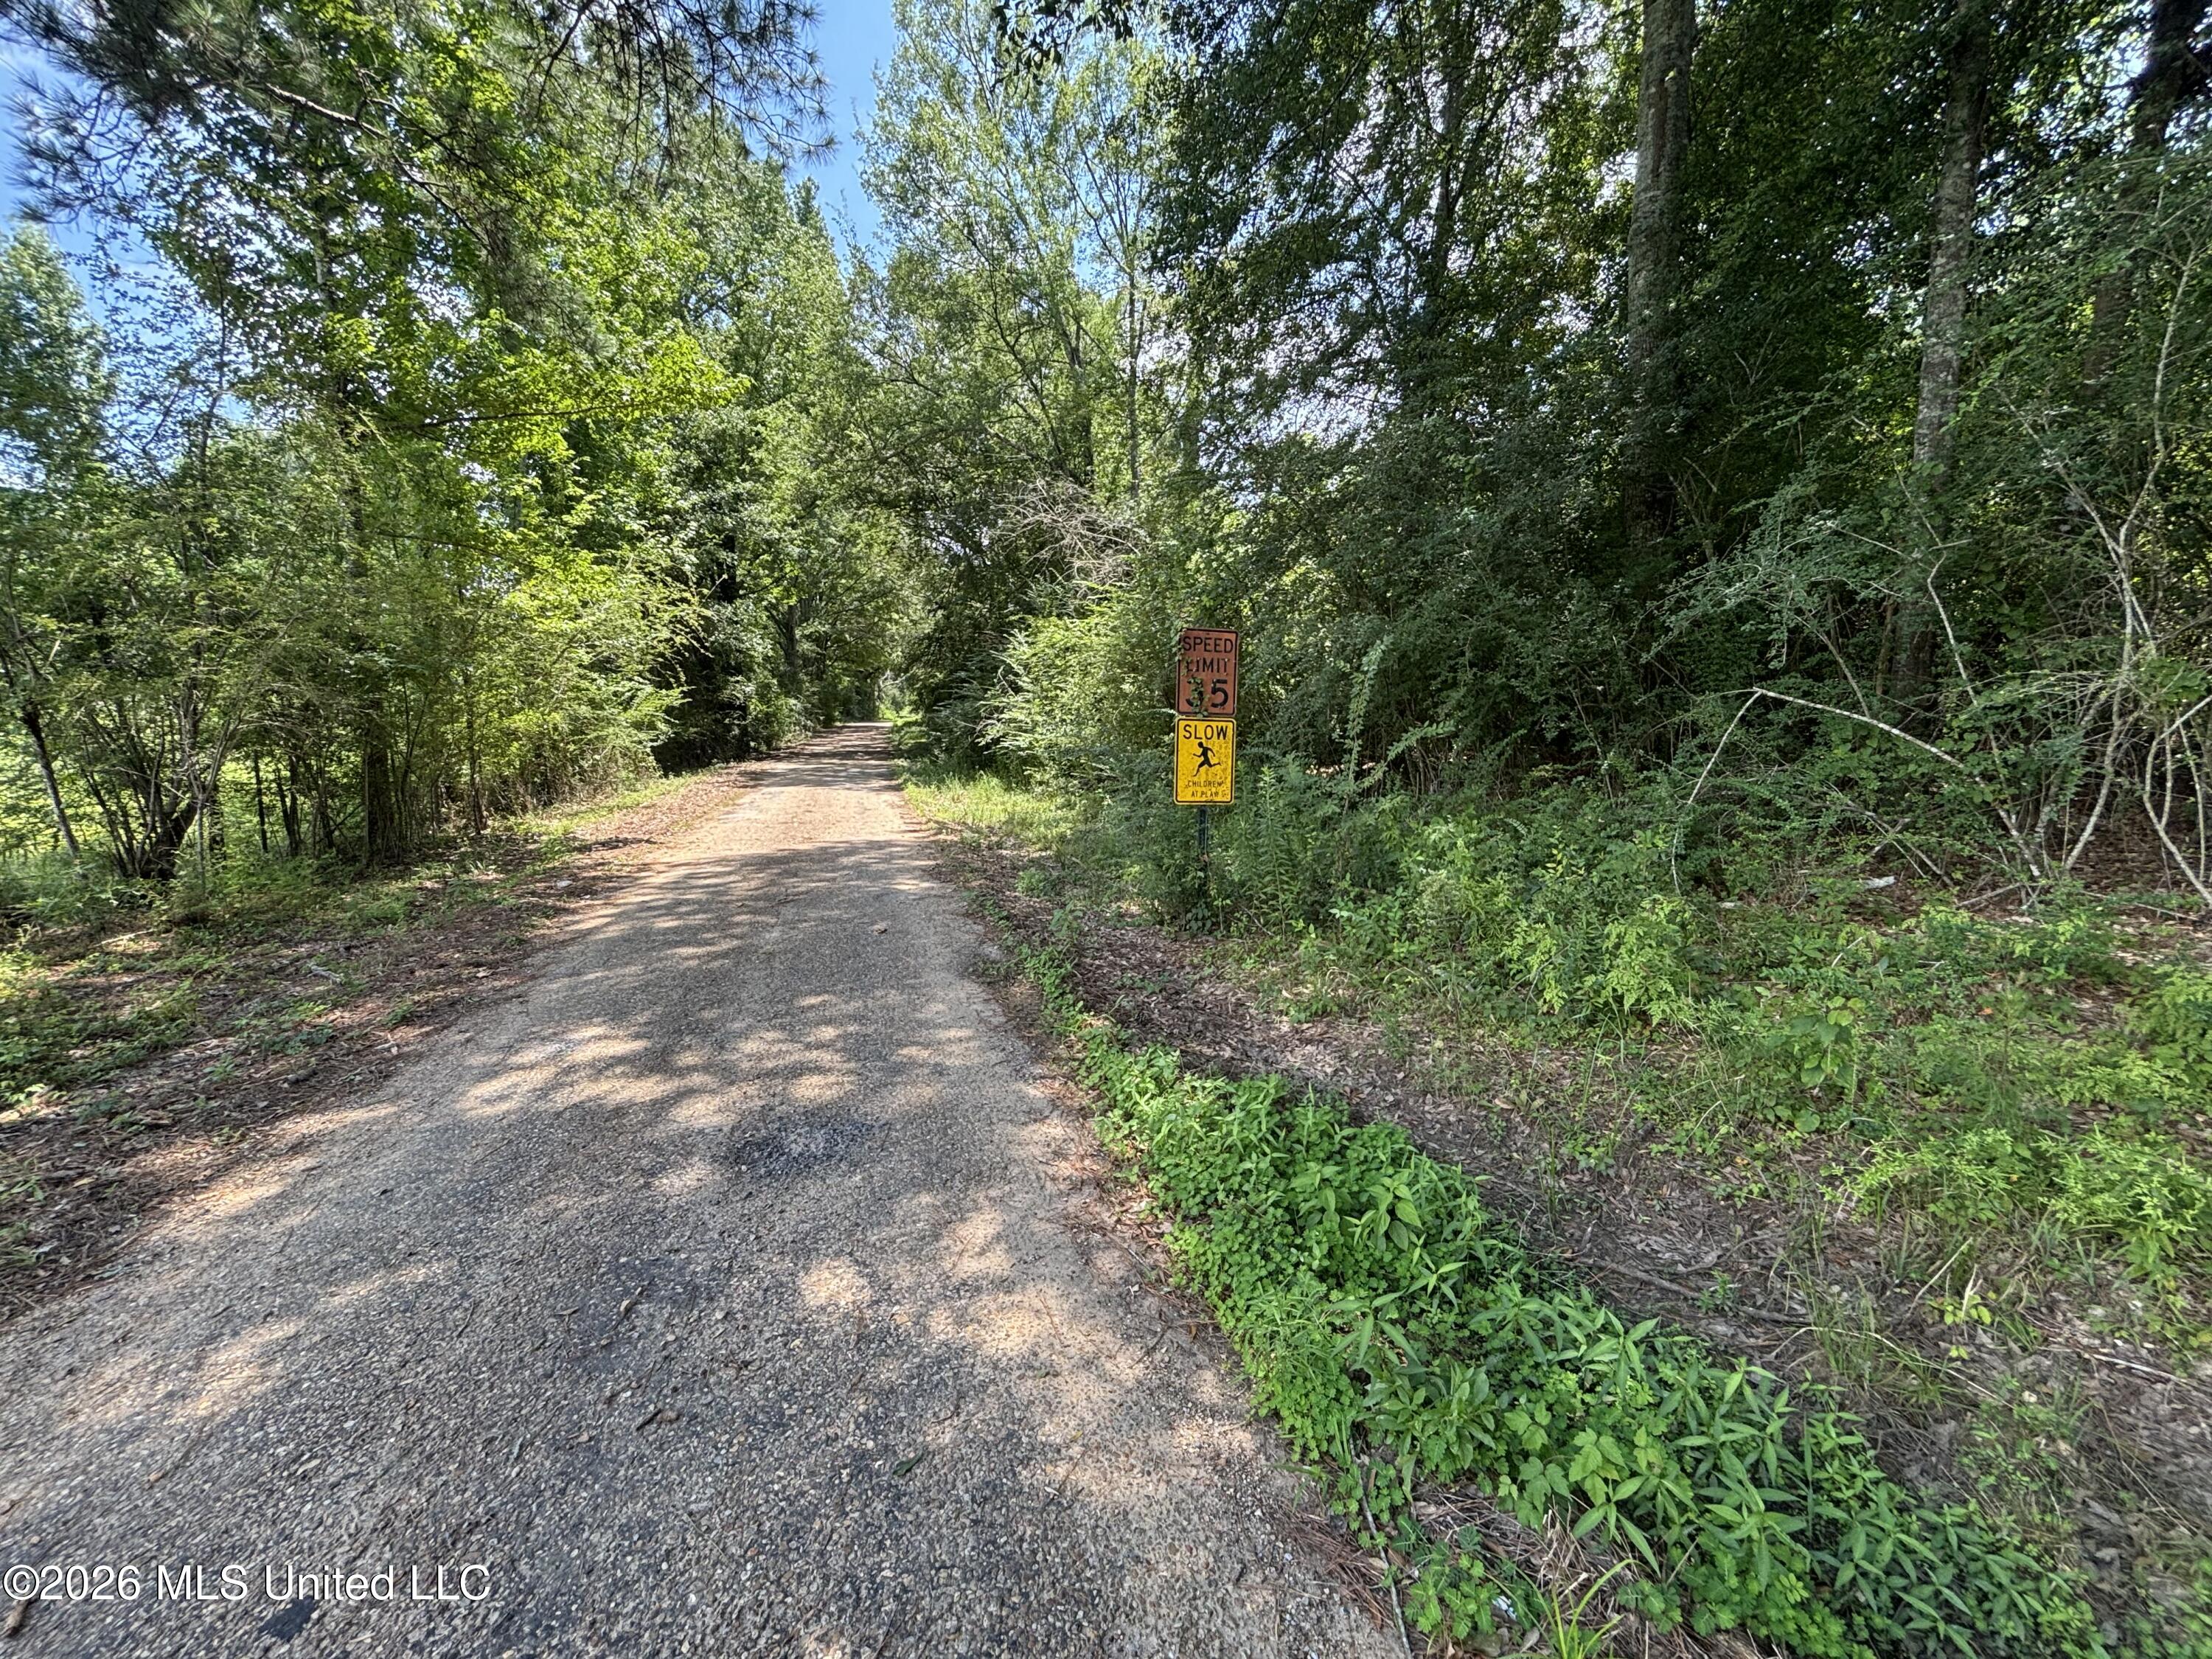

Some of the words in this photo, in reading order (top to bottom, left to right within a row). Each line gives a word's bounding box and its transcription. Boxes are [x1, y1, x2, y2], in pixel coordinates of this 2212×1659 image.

[1183, 636, 1234, 653] SPEED
[1186, 657, 1229, 673] LIMIT
[1183, 724, 1228, 740] SLOW
